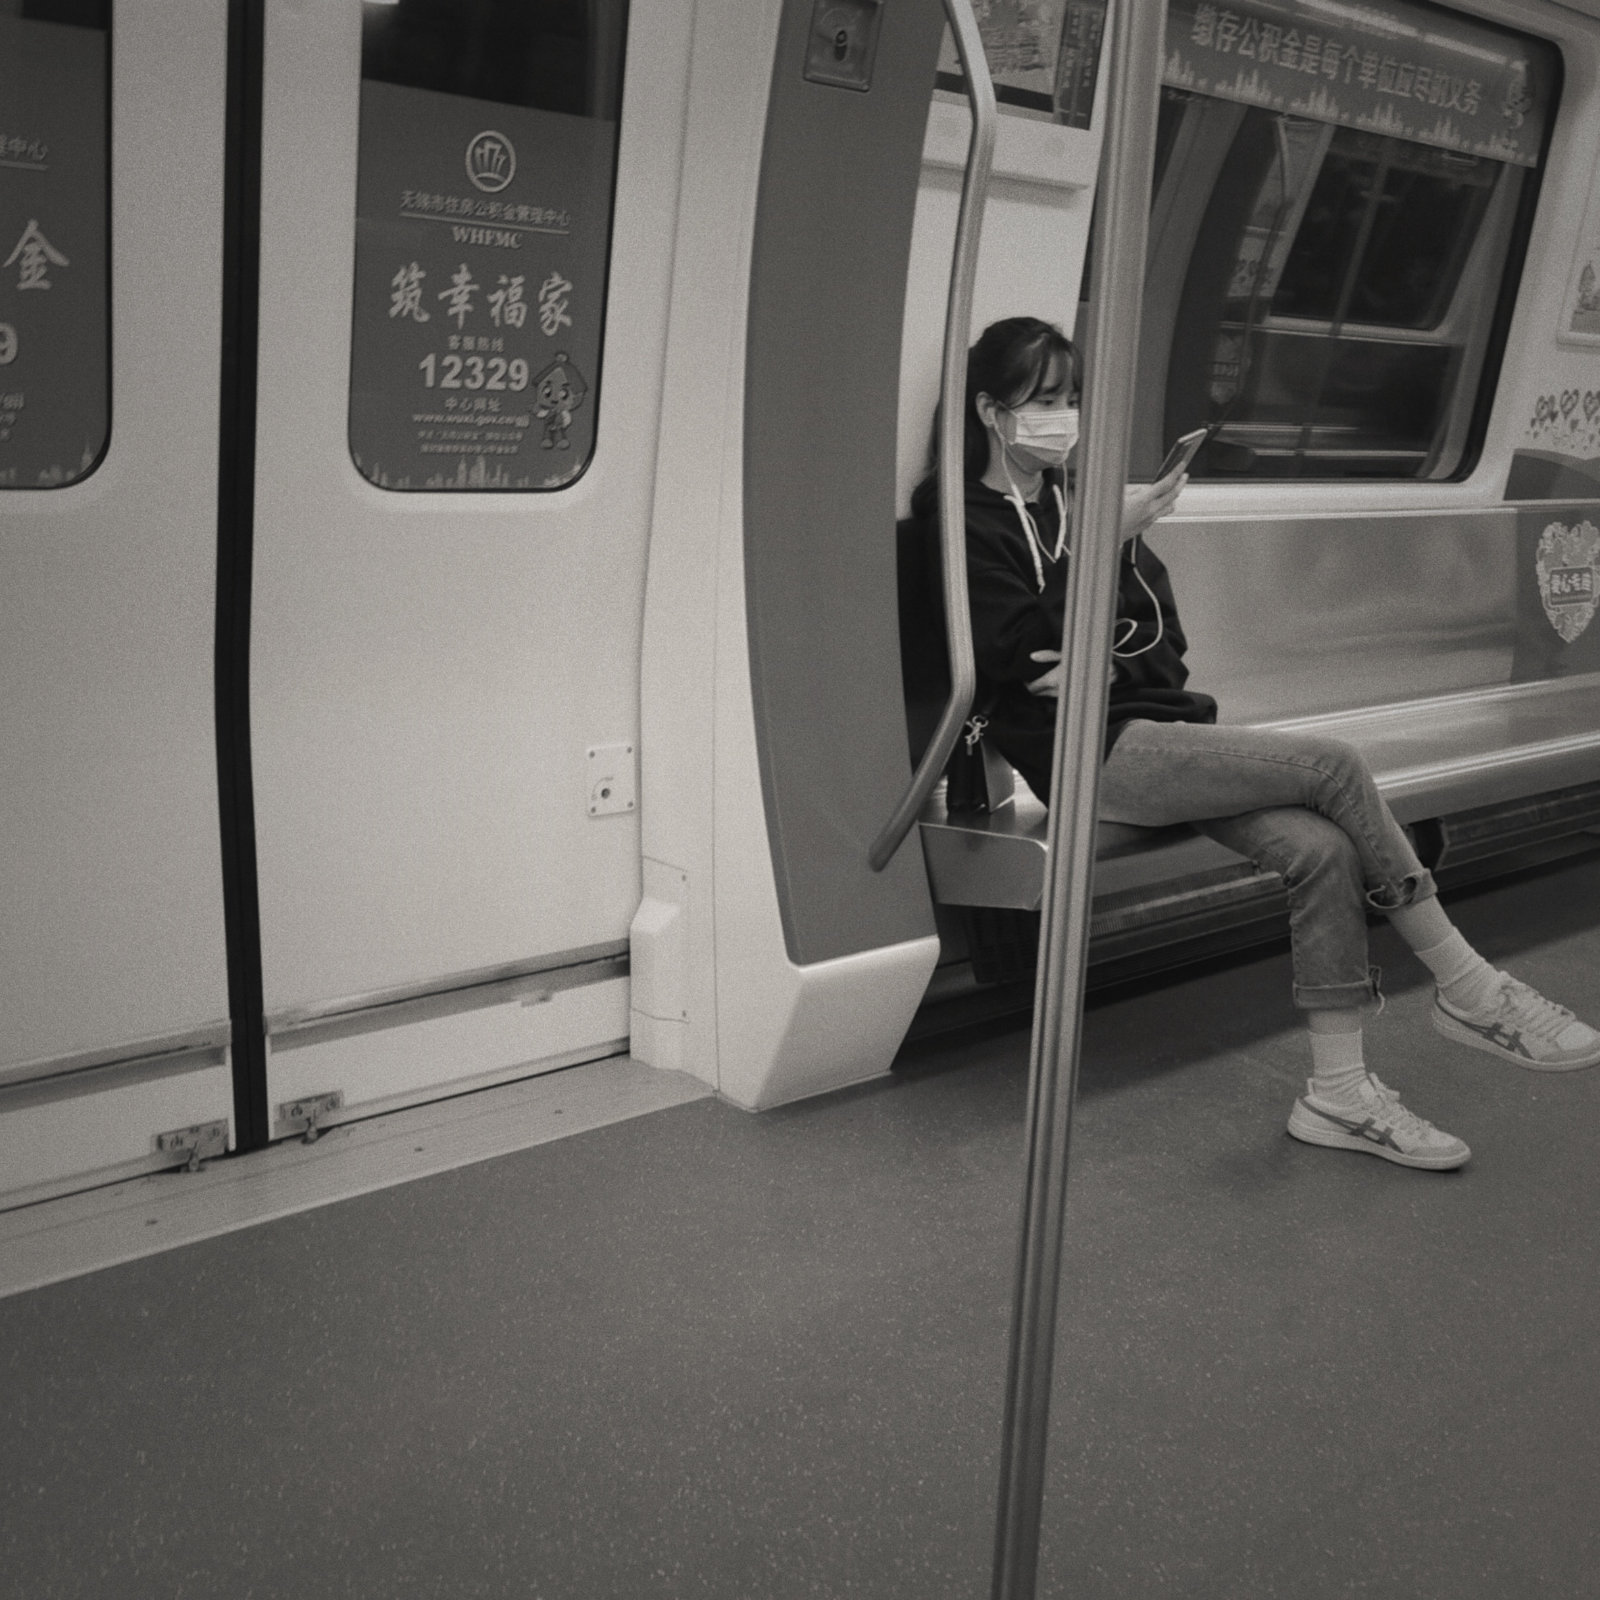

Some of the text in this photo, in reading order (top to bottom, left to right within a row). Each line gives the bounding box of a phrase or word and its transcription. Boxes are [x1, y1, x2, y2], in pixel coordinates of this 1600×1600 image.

[2, 218, 70, 290] 金
[452, 226, 523, 249] WHFMC
[389, 261, 573, 336] 筑幸福家
[419, 352, 529, 391] 12329
